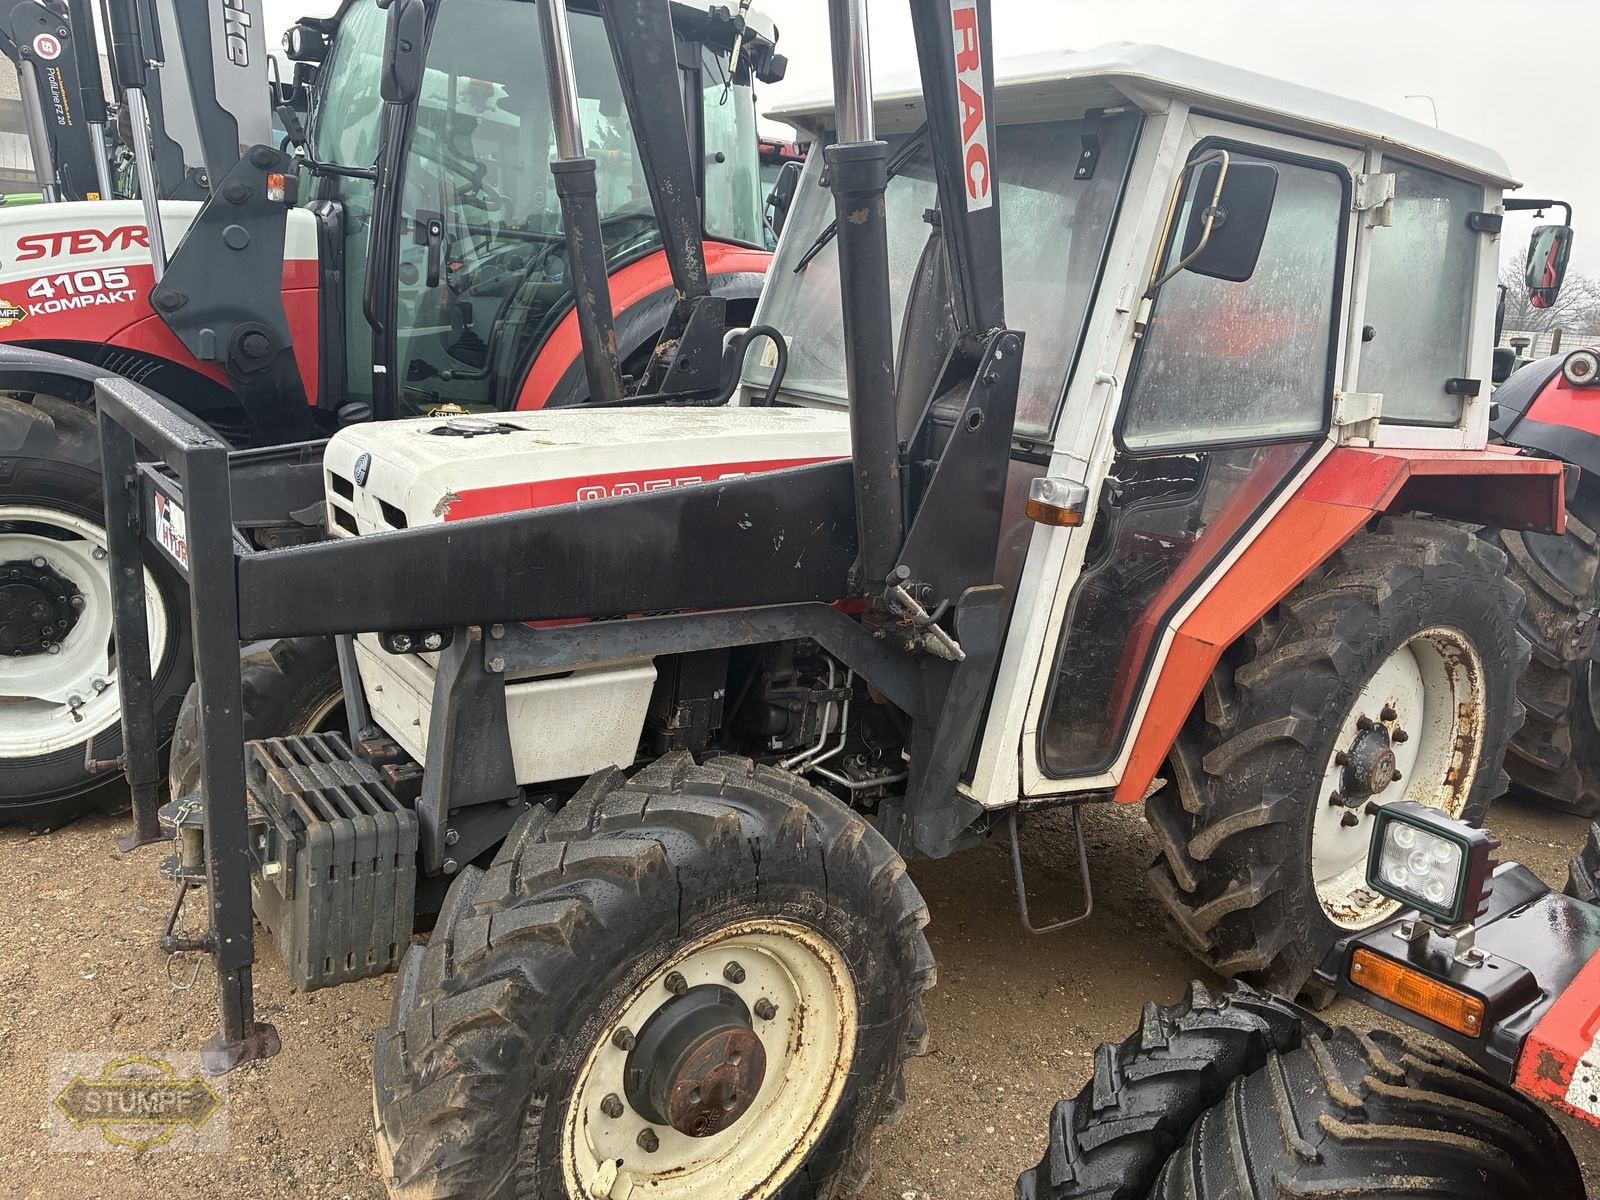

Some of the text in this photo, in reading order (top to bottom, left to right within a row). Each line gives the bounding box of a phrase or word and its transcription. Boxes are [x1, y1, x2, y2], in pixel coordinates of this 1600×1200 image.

[46, 67, 60, 103] ProfiLine
[54, 103, 64, 115] FZ
[952, 7, 989, 200] RAC
[57, 115, 66, 125] 20
[15, 225, 150, 262] STEYR
[27, 267, 130, 299] 4105
[28, 289, 137, 317] KOMPAKT
